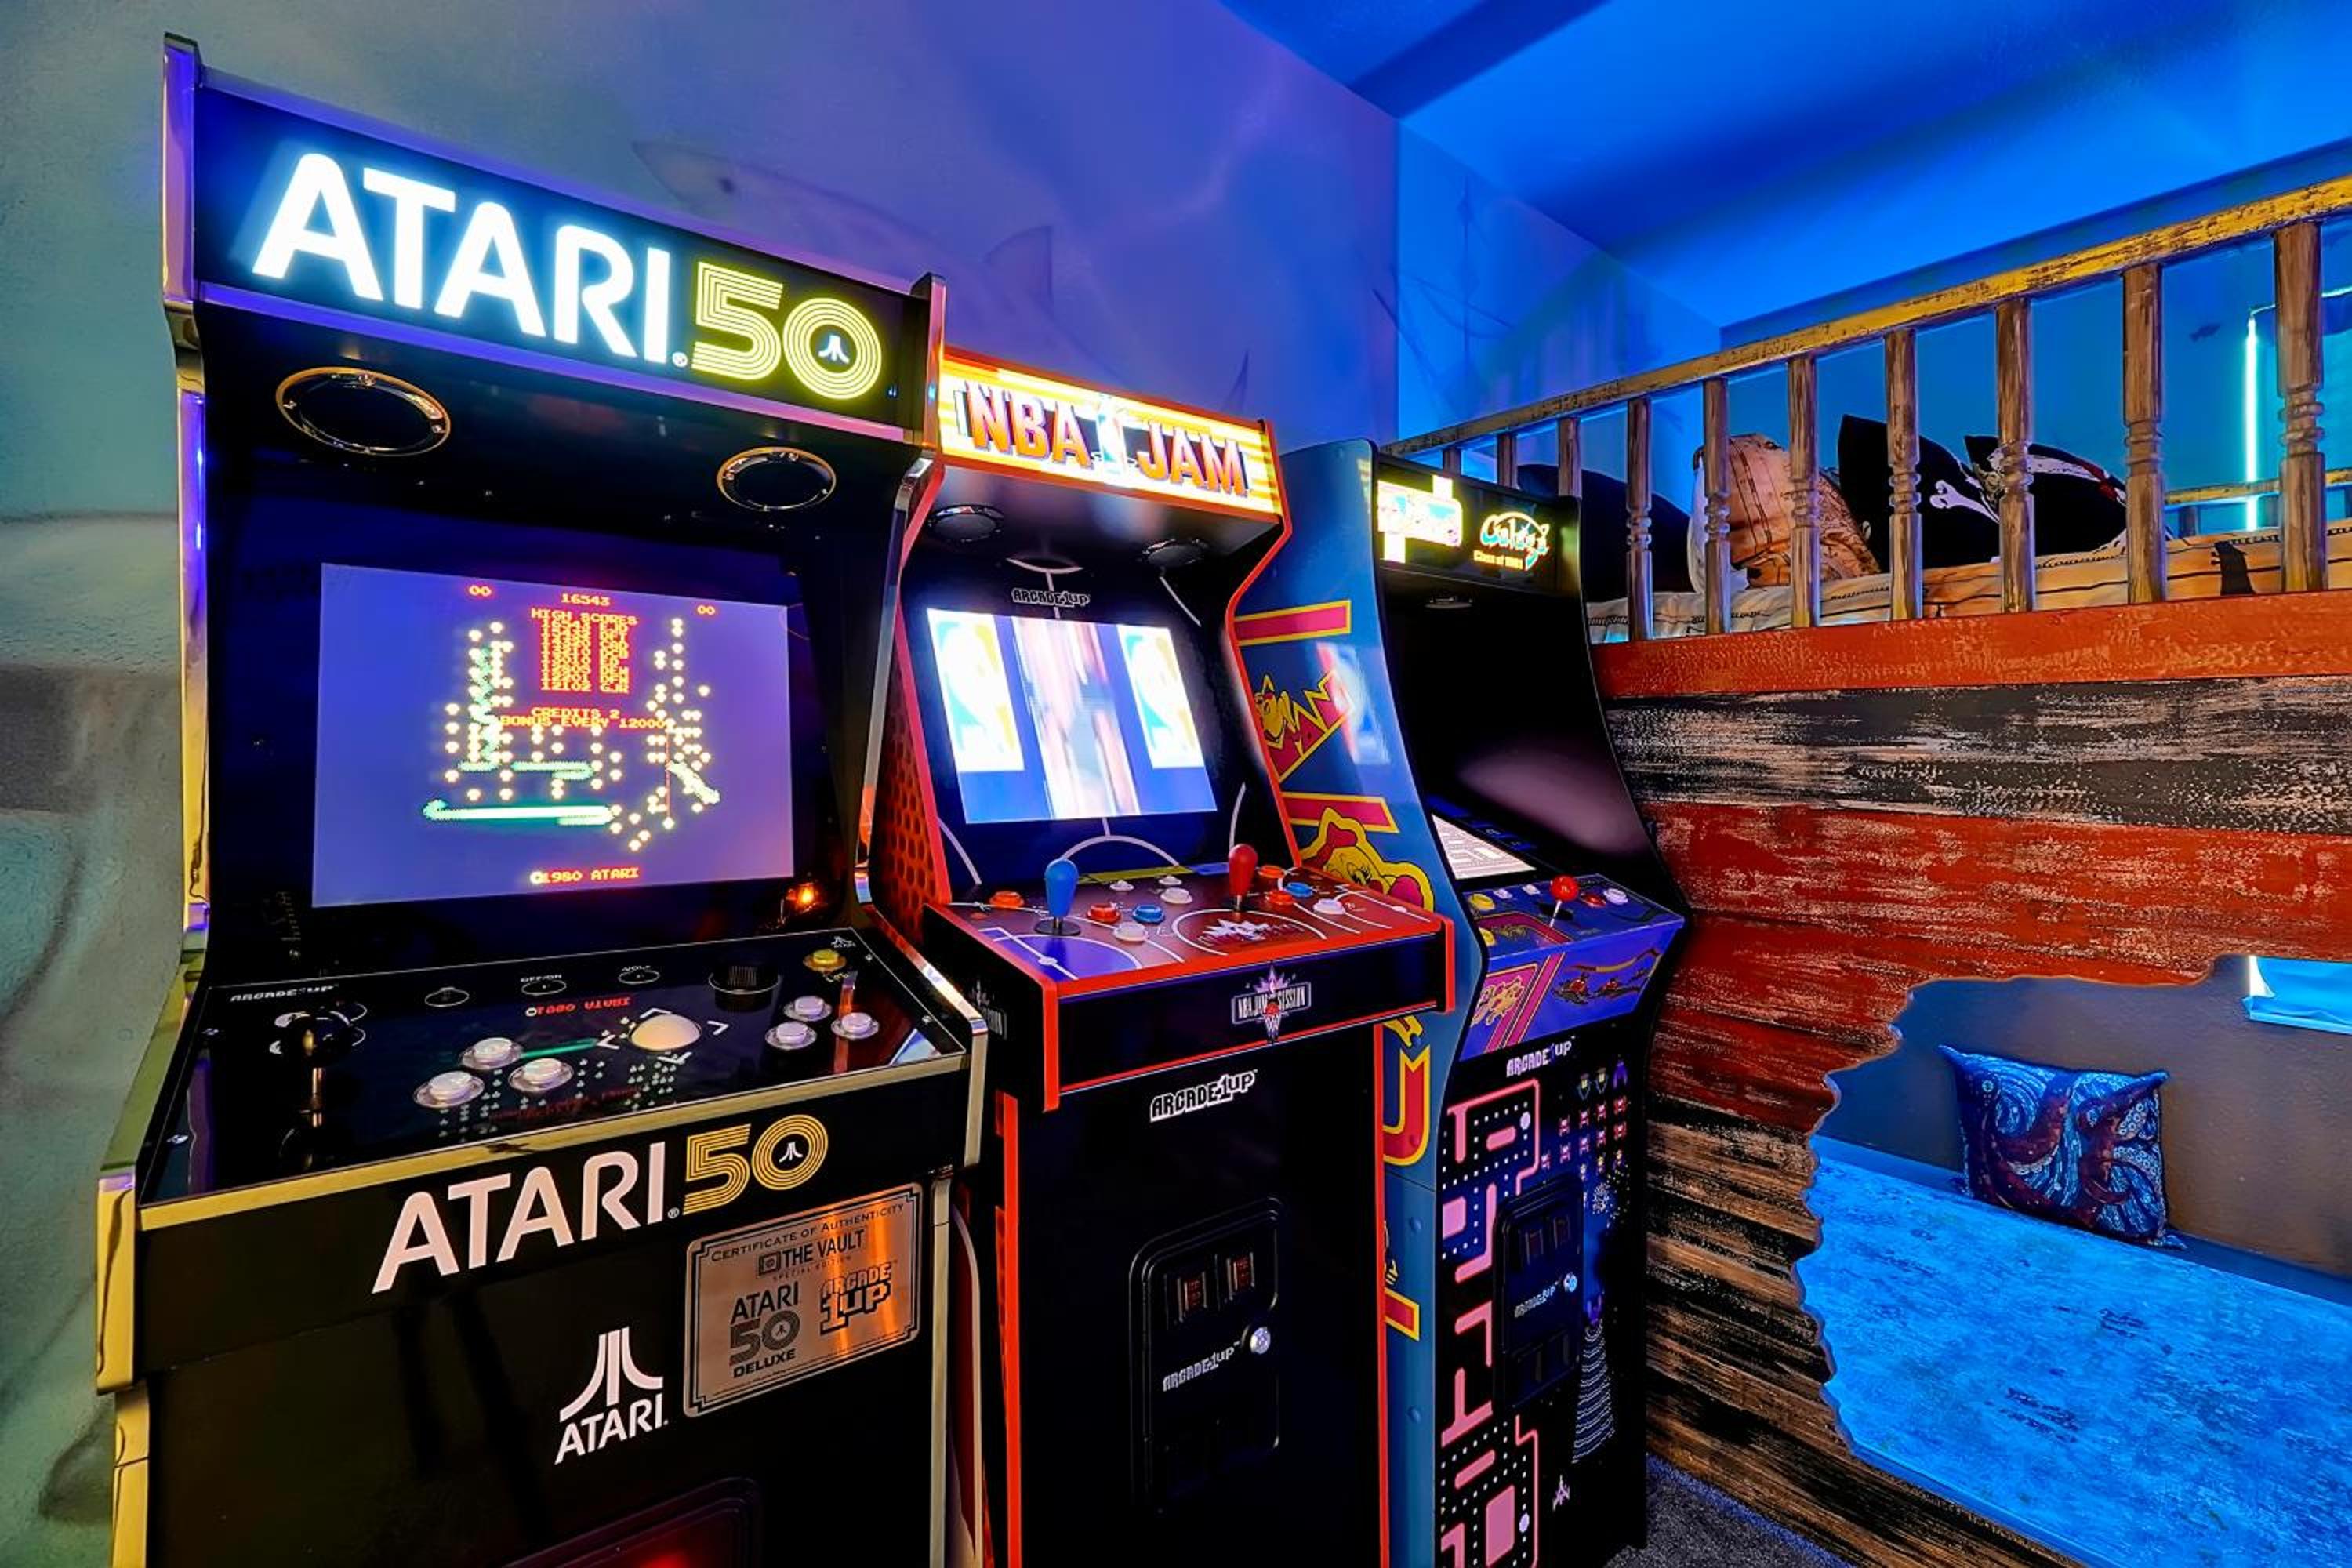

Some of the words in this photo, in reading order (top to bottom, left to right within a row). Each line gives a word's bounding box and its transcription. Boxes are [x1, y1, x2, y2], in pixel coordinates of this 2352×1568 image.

[692, 260, 883, 401] 50
[964, 381, 1094, 470] NBA
[1135, 421, 1250, 497] JAM
[531, 707, 601, 719] CREDITS
[590, 867, 639, 880] ATARI
[682, 1114, 829, 1215] 50
[782, 1243, 814, 1268] THE
[817, 1229, 866, 1257] VAULT
[731, 1281, 799, 1325] ATARI
[730, 1310, 800, 1367] 50
[733, 1348, 796, 1378] DELUXE
[554, 1393, 665, 1465] ATARI
